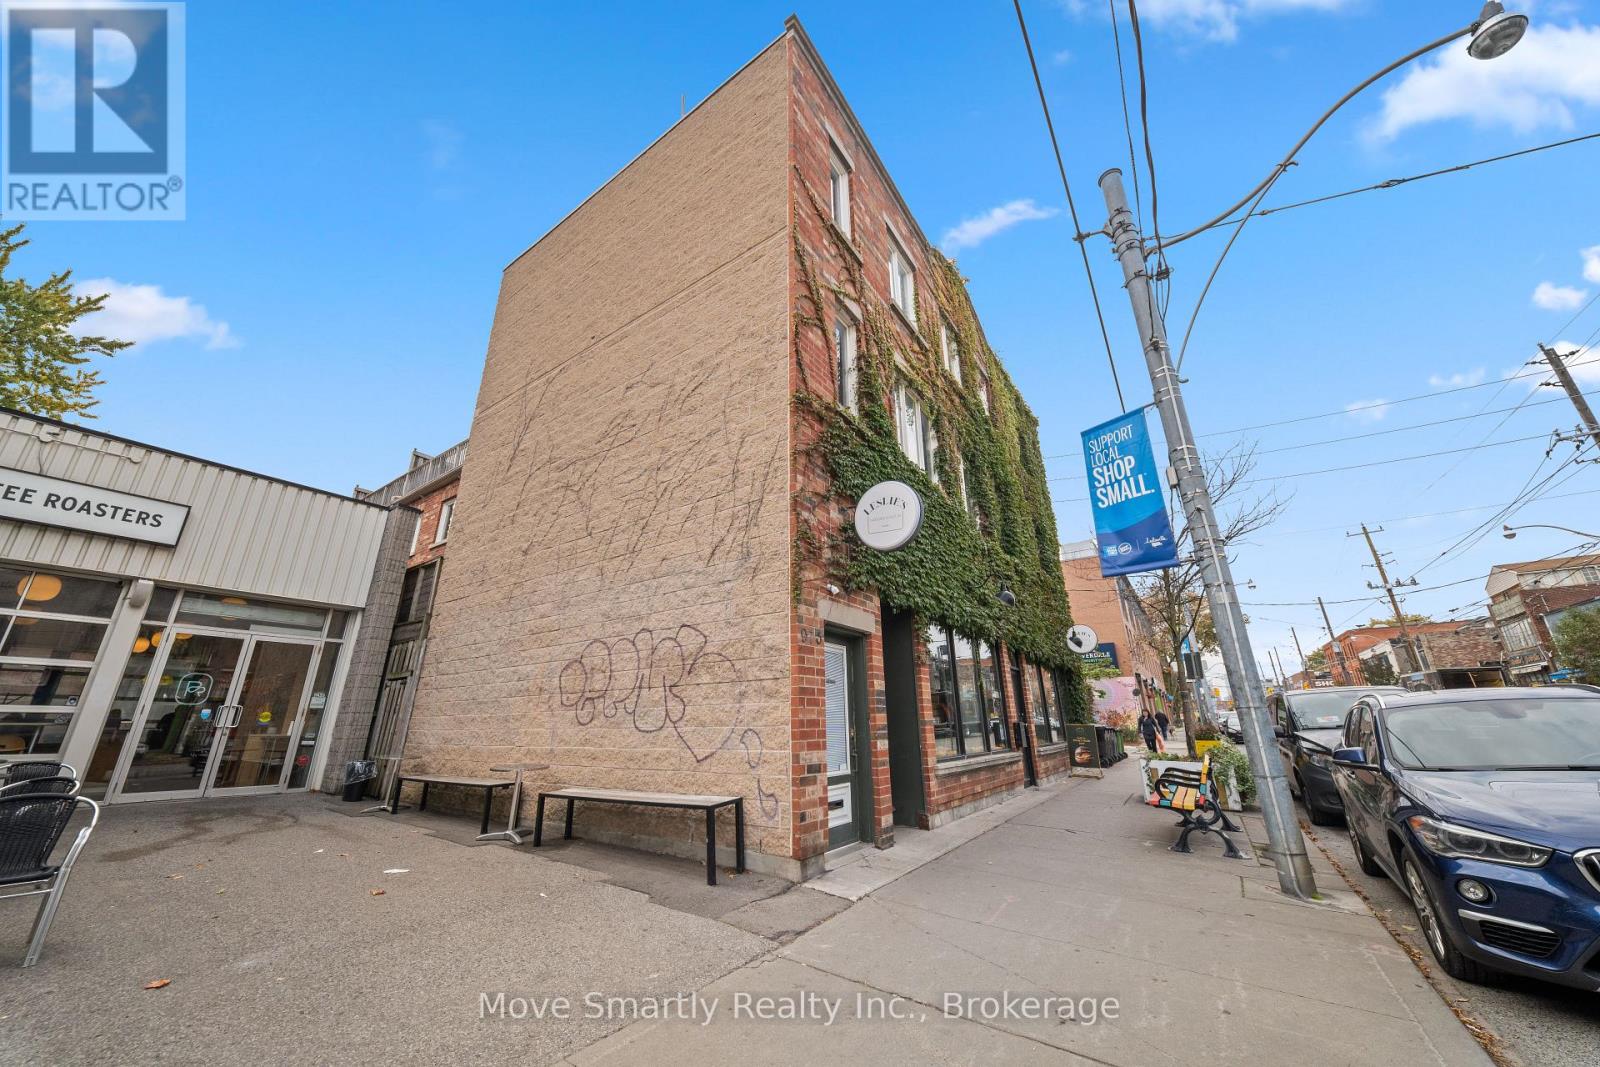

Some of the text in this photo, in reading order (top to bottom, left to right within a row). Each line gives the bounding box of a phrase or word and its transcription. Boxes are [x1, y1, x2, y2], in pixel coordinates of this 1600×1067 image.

[1088, 424, 1133, 454] SUPPORT
[1090, 445, 1124, 468] LOCAL
[1092, 455, 1136, 488] SHOP
[0, 483, 164, 528] EE ROASTERS
[1096, 473, 1156, 508] SMALL.
